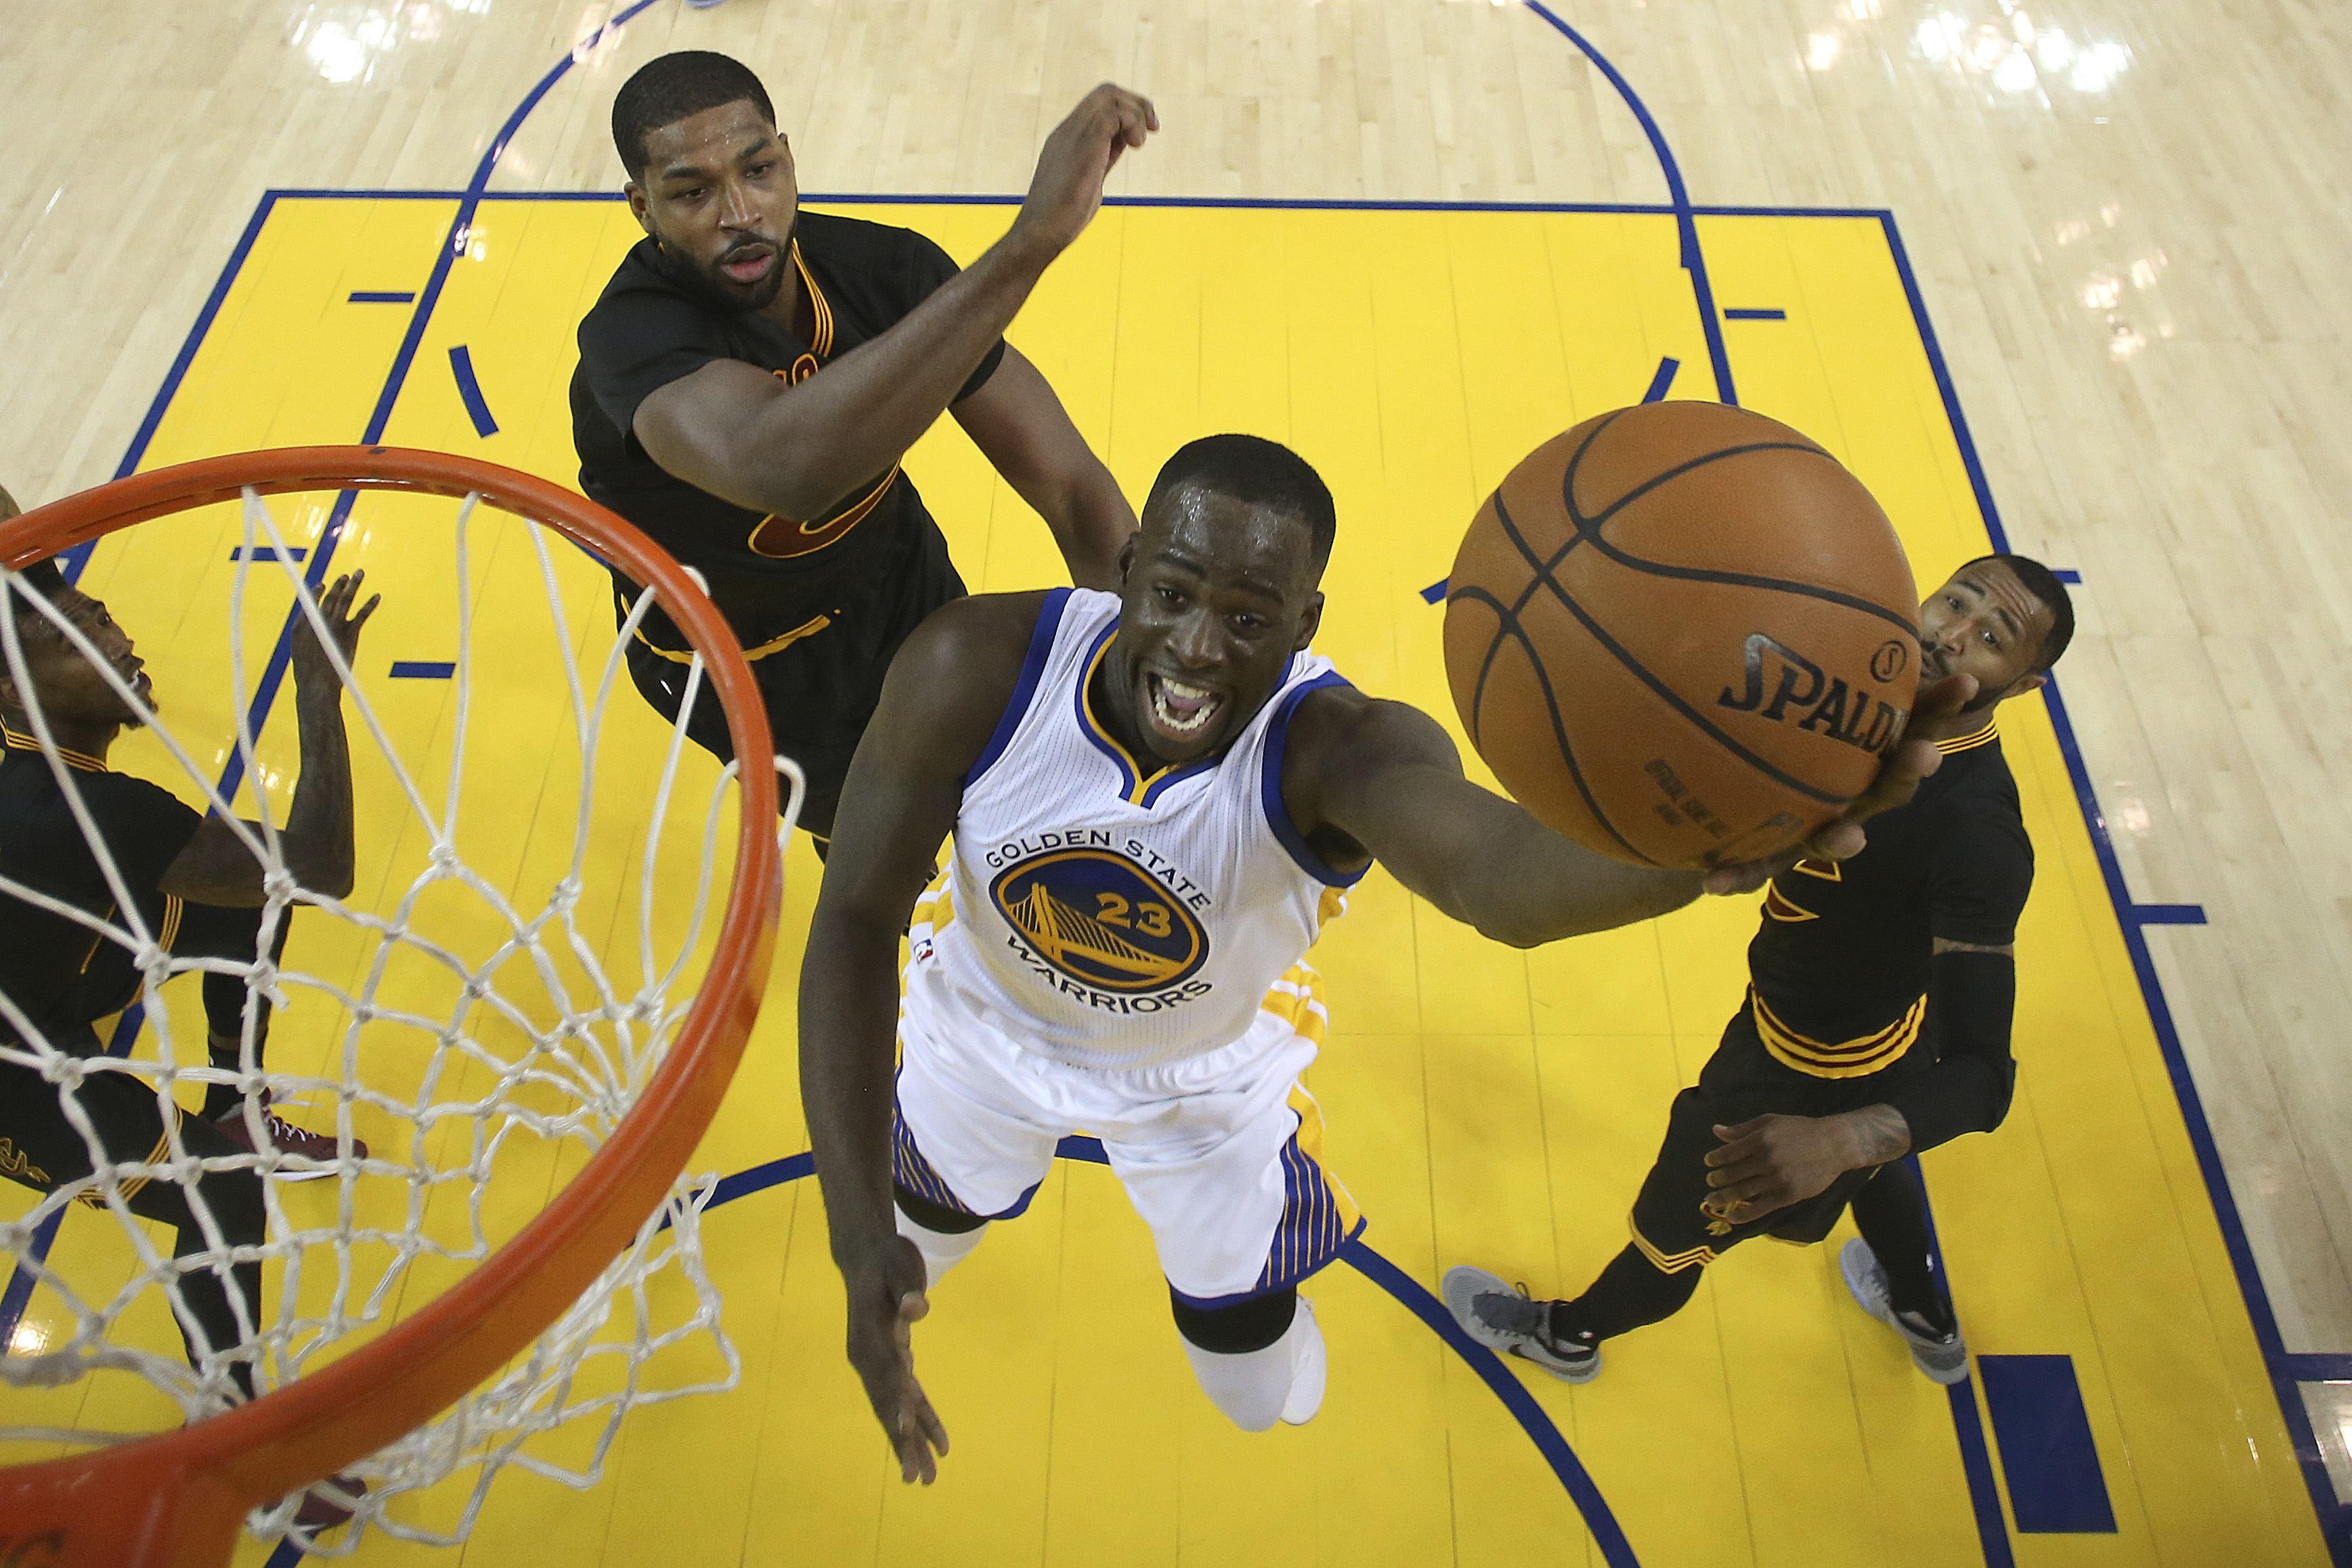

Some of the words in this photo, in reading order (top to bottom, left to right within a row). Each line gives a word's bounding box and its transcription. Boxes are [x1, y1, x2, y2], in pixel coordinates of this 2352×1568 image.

[986, 829, 1111, 868] GOLDEN
[1125, 839, 1211, 911] STATE
[1095, 892, 1173, 938] 23
[1007, 936, 1213, 1014] WARRIORS
